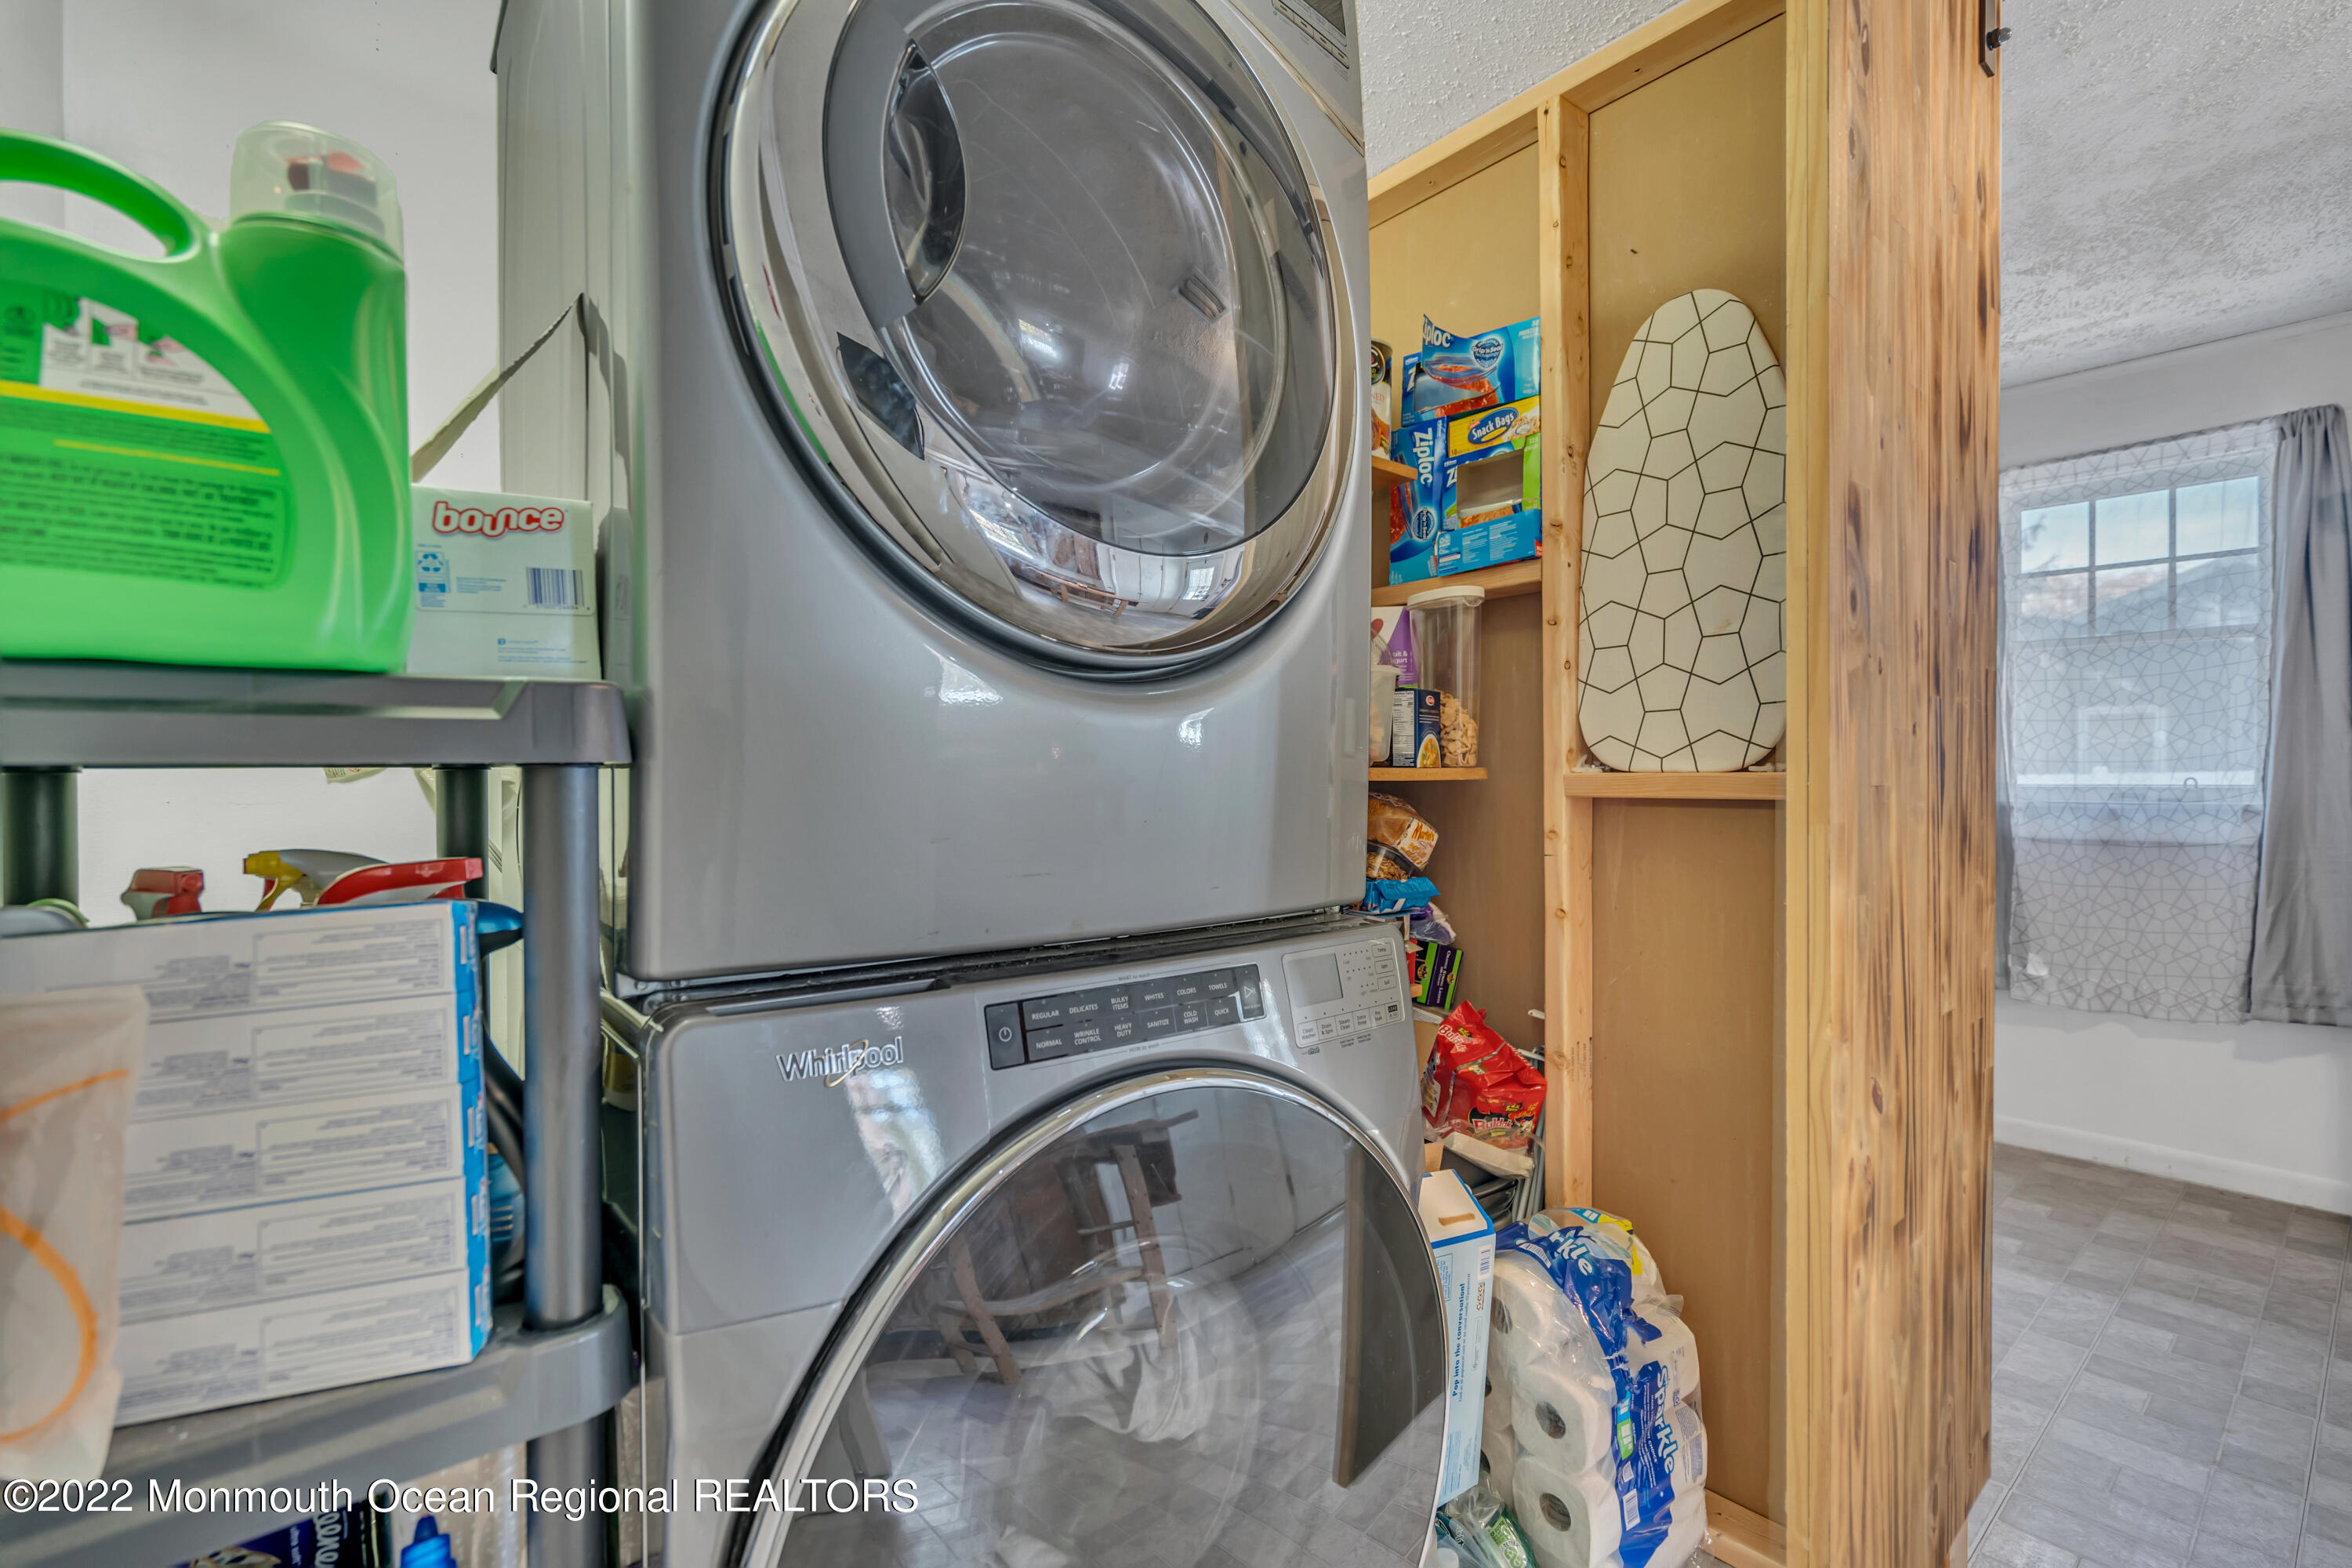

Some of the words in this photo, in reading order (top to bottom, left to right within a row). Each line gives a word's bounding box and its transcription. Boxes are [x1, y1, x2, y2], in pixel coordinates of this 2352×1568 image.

[1490, 343, 1503, 352] Seal
[1472, 420, 1494, 440] Snack
[1495, 412, 1514, 428] Bags
[1413, 427, 1435, 484] Ziploc
[433, 501, 564, 538] bounce
[1177, 987, 1196, 996] COLORS
[1208, 982, 1228, 991] TOWELS
[1111, 996, 1128, 1004] BULKY
[1144, 993, 1164, 1001] WHITES
[1069, 1004, 1098, 1014] DELICATES
[1031, 1010, 1060, 1020] REGULAR
[1114, 1022, 1132, 1031] HEAVY
[1147, 1018, 1170, 1029] SANITIZE
[1074, 1029, 1100, 1039] WRINKLE
[1036, 1039, 1063, 1049] NORMAL
[1074, 1036, 1102, 1046] CONTROL
[776, 1036, 904, 1082] Whirlpool
[1472, 1117, 1513, 1133] Buldak
[1457, 1283, 1465, 1341] conversation!
[1657, 1365, 1679, 1474] Sparkle
[1648, 1440, 1658, 1464] CHOICE
